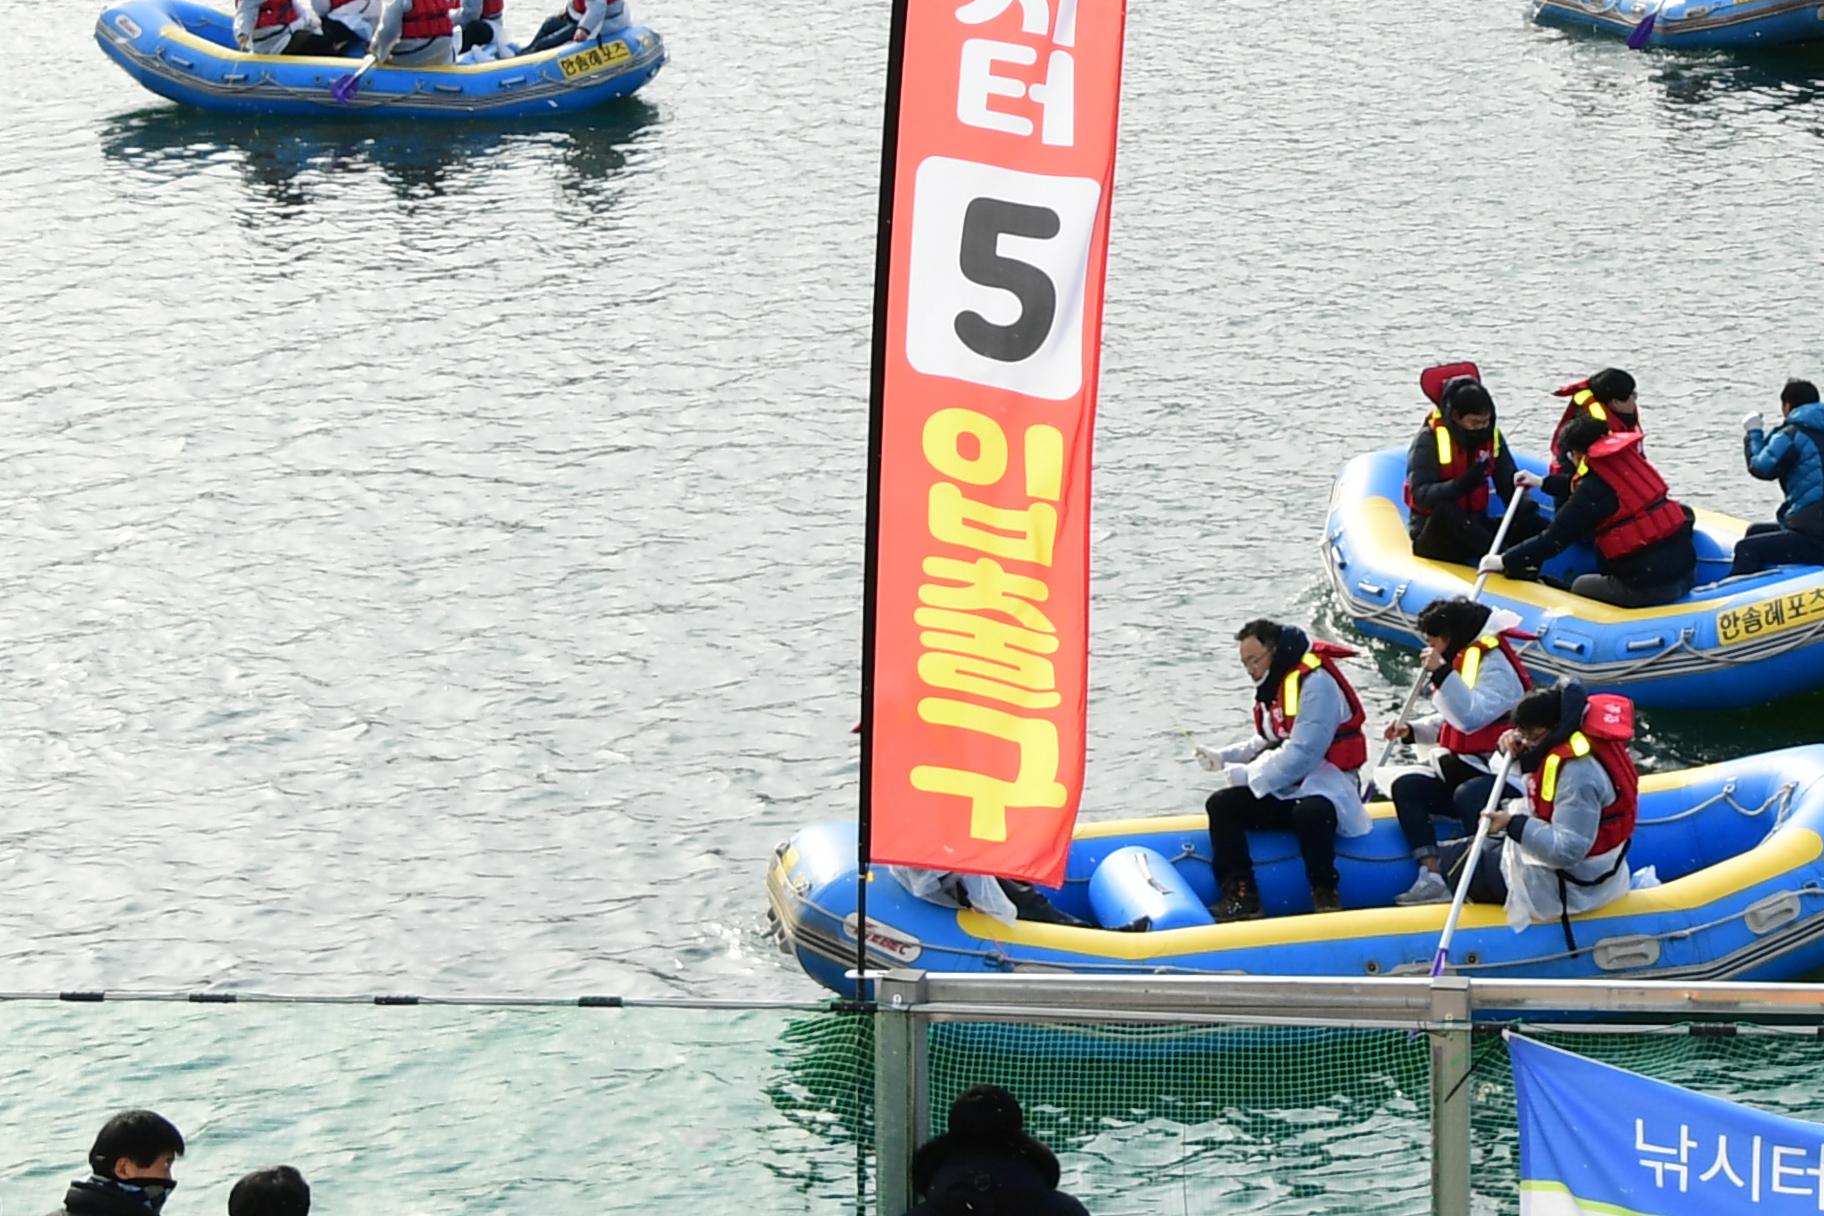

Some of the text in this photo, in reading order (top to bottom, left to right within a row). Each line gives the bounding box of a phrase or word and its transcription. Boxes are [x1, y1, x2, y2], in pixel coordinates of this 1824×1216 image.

[560, 40, 628, 79] 한솔레포츠
[953, 195, 1061, 363] 5
[909, 406, 1068, 842] 입출구
